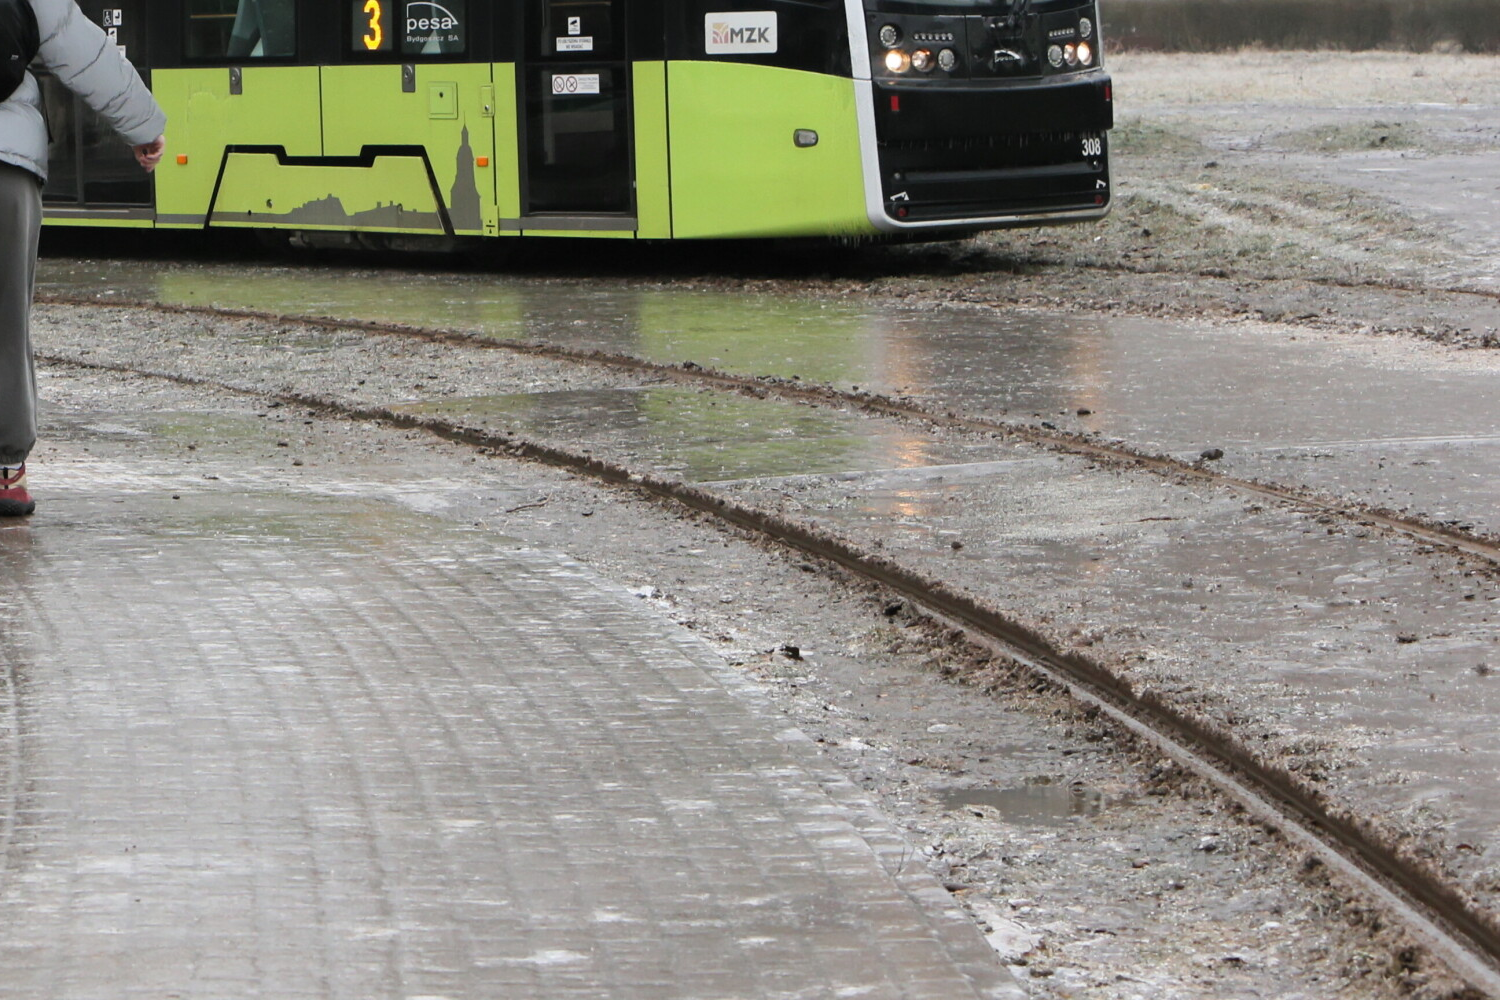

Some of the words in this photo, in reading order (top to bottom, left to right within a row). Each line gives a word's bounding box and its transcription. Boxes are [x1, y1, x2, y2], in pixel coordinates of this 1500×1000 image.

[406, 16, 452, 34] pesa
[730, 27, 770, 44] MZK
[1081, 138, 1101, 156] 308
